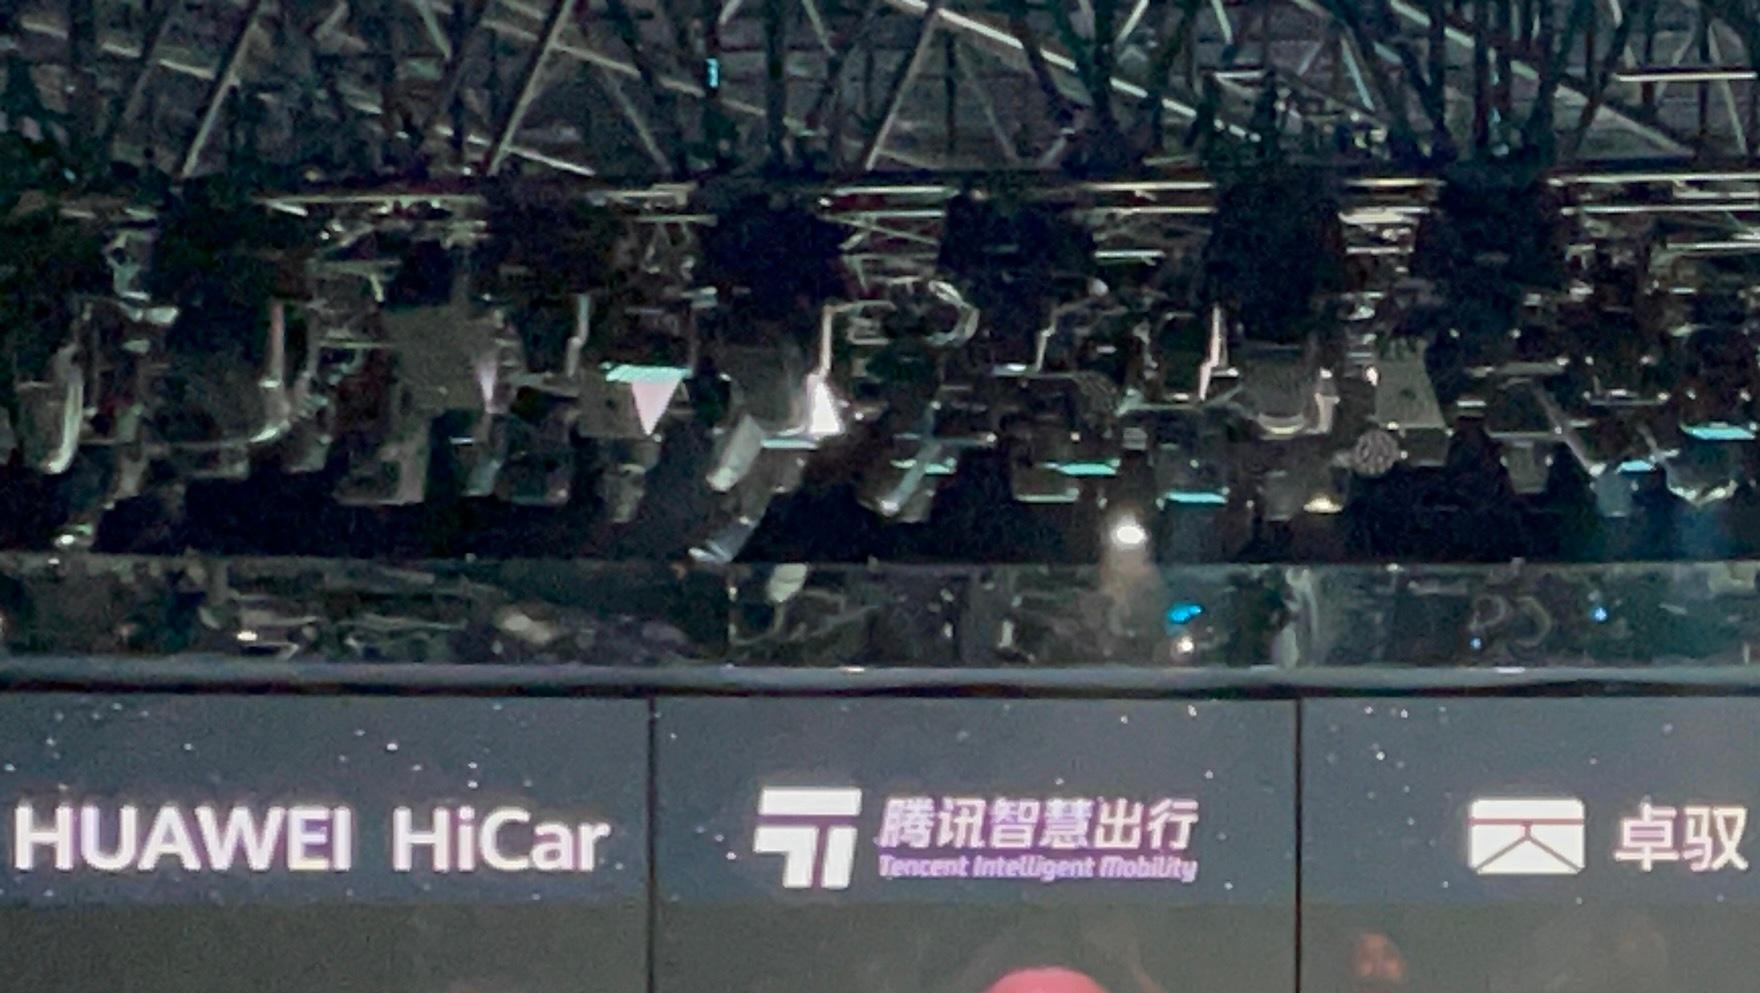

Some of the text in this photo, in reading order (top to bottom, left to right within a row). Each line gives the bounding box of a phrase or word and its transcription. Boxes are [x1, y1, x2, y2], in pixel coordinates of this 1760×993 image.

[14, 806, 612, 872] HUAWEI HiCar
[880, 797, 1199, 849] 腾讯智慧出行
[1613, 799, 1749, 872] 卓驭
[879, 856, 1197, 883] Tencent Intelligent Mobility
